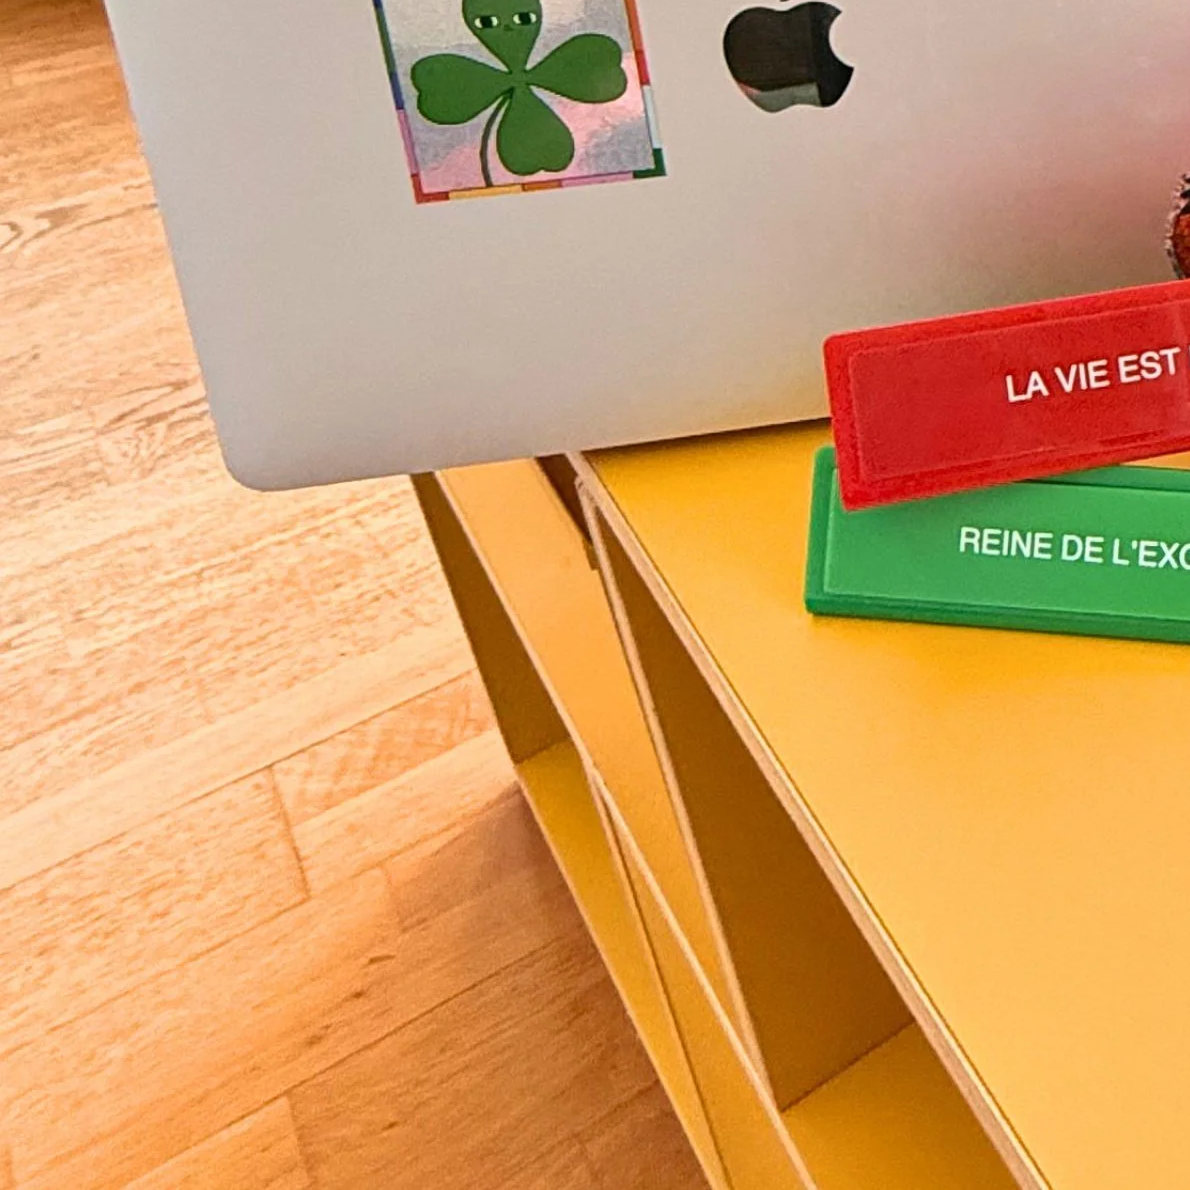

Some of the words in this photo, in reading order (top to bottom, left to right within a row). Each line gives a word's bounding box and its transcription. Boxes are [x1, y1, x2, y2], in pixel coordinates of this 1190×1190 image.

[1006, 369, 1049, 403] LA
[1055, 359, 1110, 395] VIE
[1118, 347, 1181, 383] EST
[959, 526, 1053, 559] REINE
[1062, 534, 1105, 563] DE
